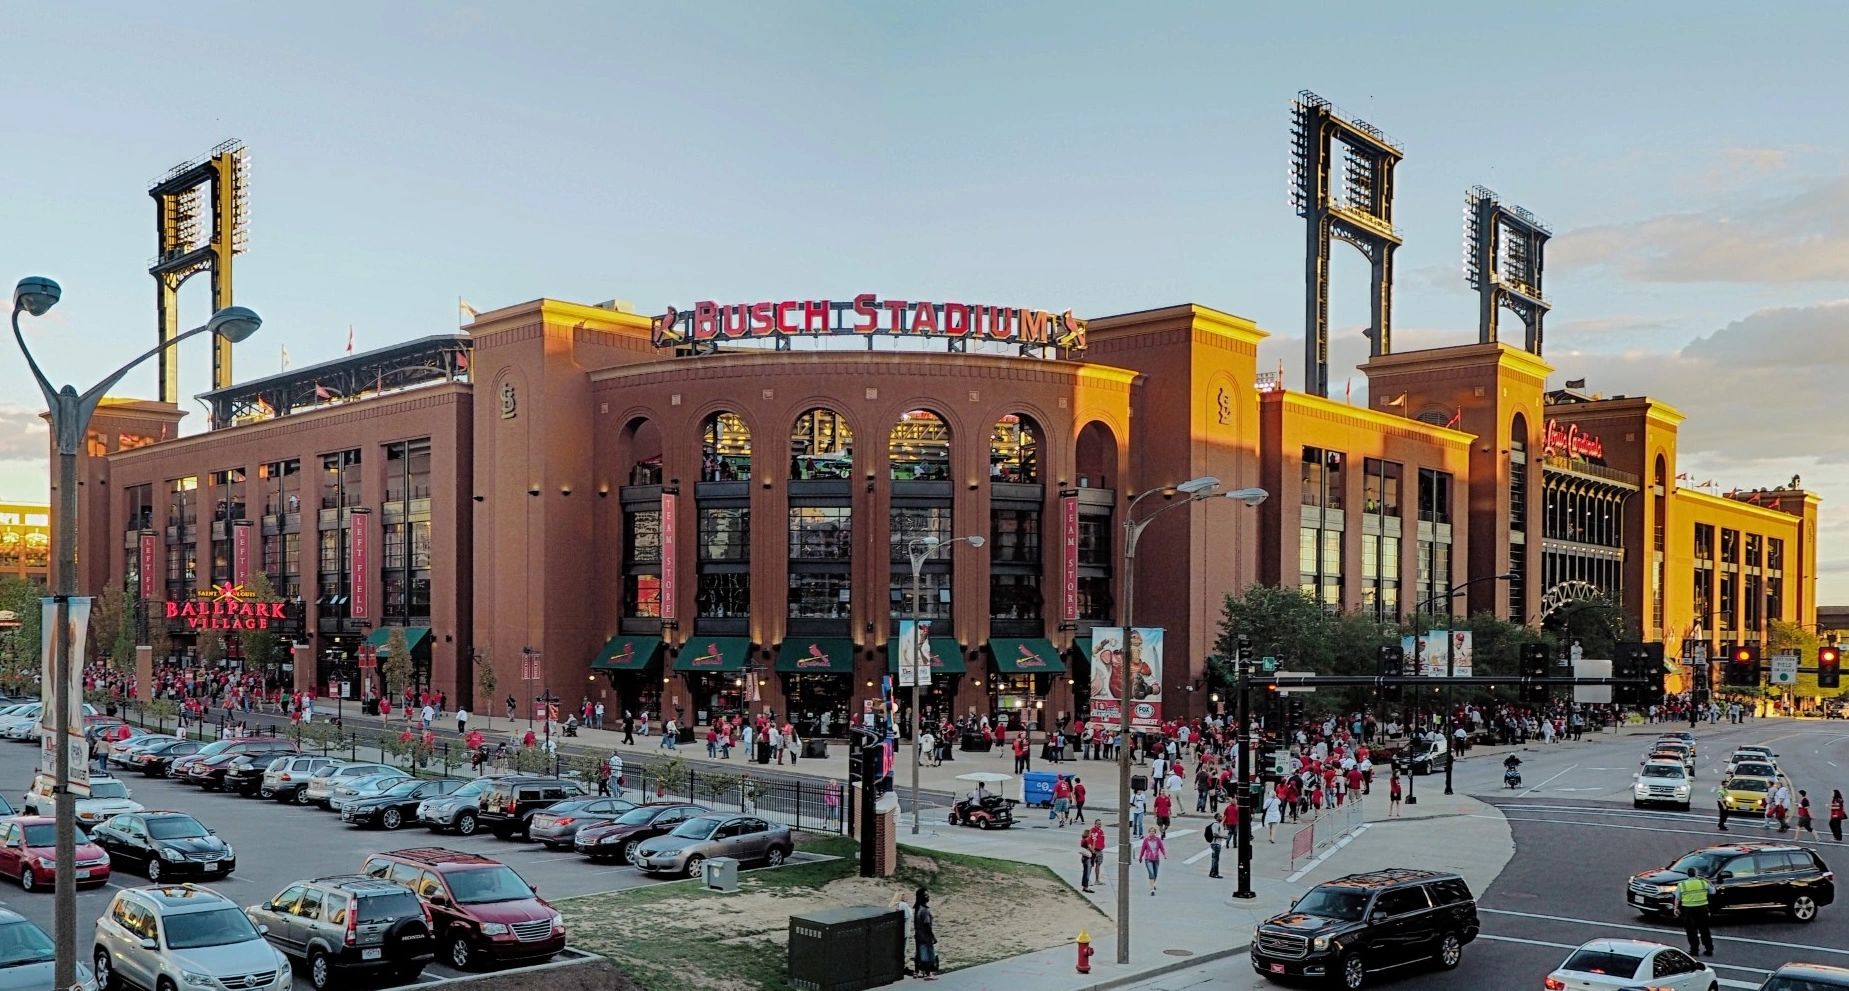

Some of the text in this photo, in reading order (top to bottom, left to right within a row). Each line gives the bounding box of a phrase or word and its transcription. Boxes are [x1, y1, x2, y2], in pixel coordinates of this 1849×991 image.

[694, 293, 1050, 344] BUSCH STADIUM
[166, 601, 286, 619] BALLPARK
[188, 618, 268, 629] VILLAGE
